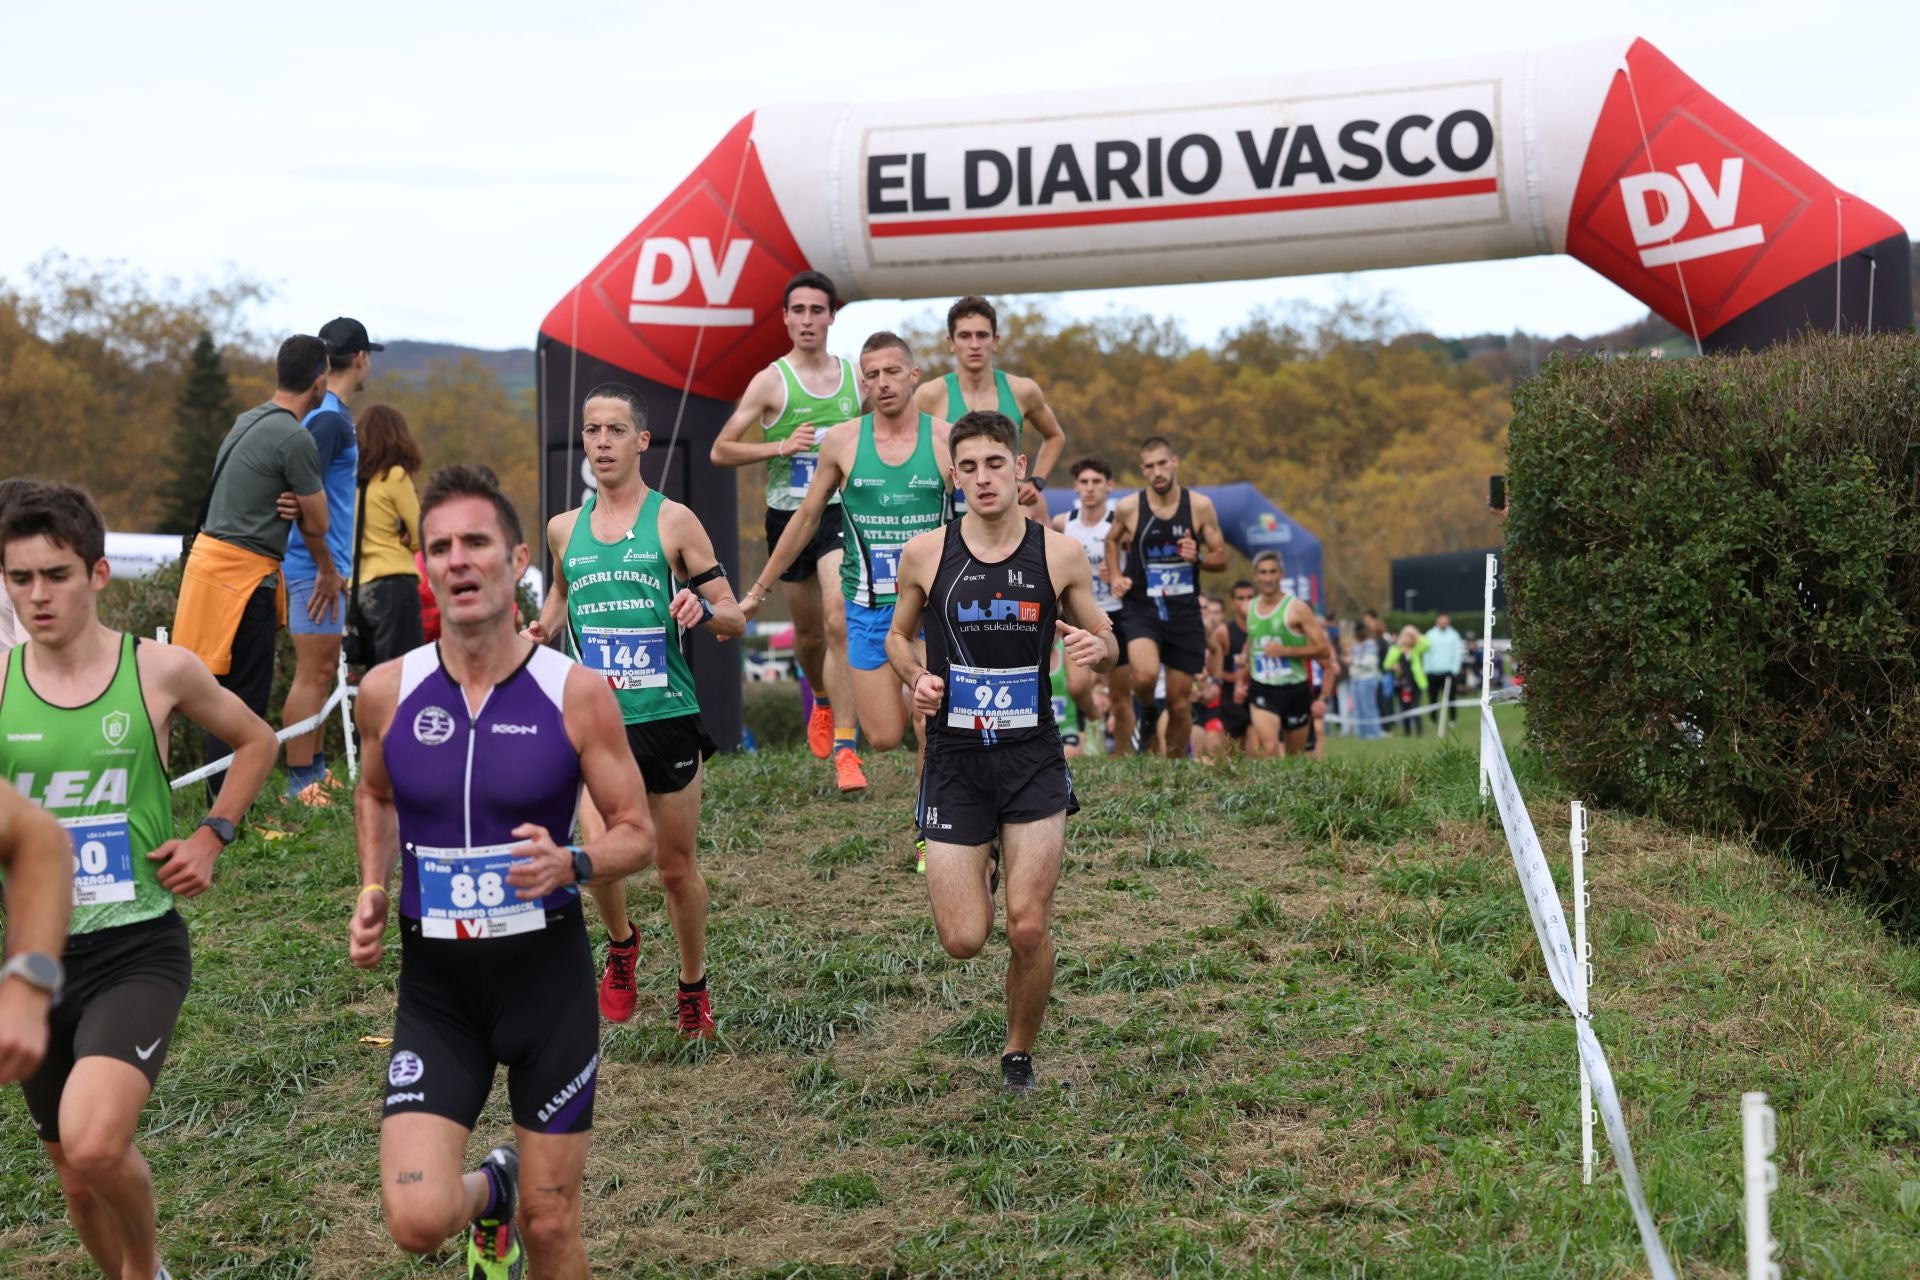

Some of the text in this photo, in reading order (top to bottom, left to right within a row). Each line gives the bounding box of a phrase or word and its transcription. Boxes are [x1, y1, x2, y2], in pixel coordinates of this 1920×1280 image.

[868, 109, 1494, 214] EL DIARIO VASCO
[1619, 157, 1744, 246] DV
[631, 236, 754, 305] DV
[853, 514, 900, 525] GOIERRI
[614, 570, 661, 591] GARAIA
[1161, 573, 1180, 585] 97
[576, 599, 655, 616] ATLETISMO
[959, 621, 1038, 632] uria sukaldeak
[600, 645, 651, 668] 146
[596, 669, 620, 677] NDIKA
[974, 685, 1012, 709] 96
[953, 706, 984, 716] BINGEN
[16, 768, 128, 808] LEA
[451, 872, 505, 909] 88
